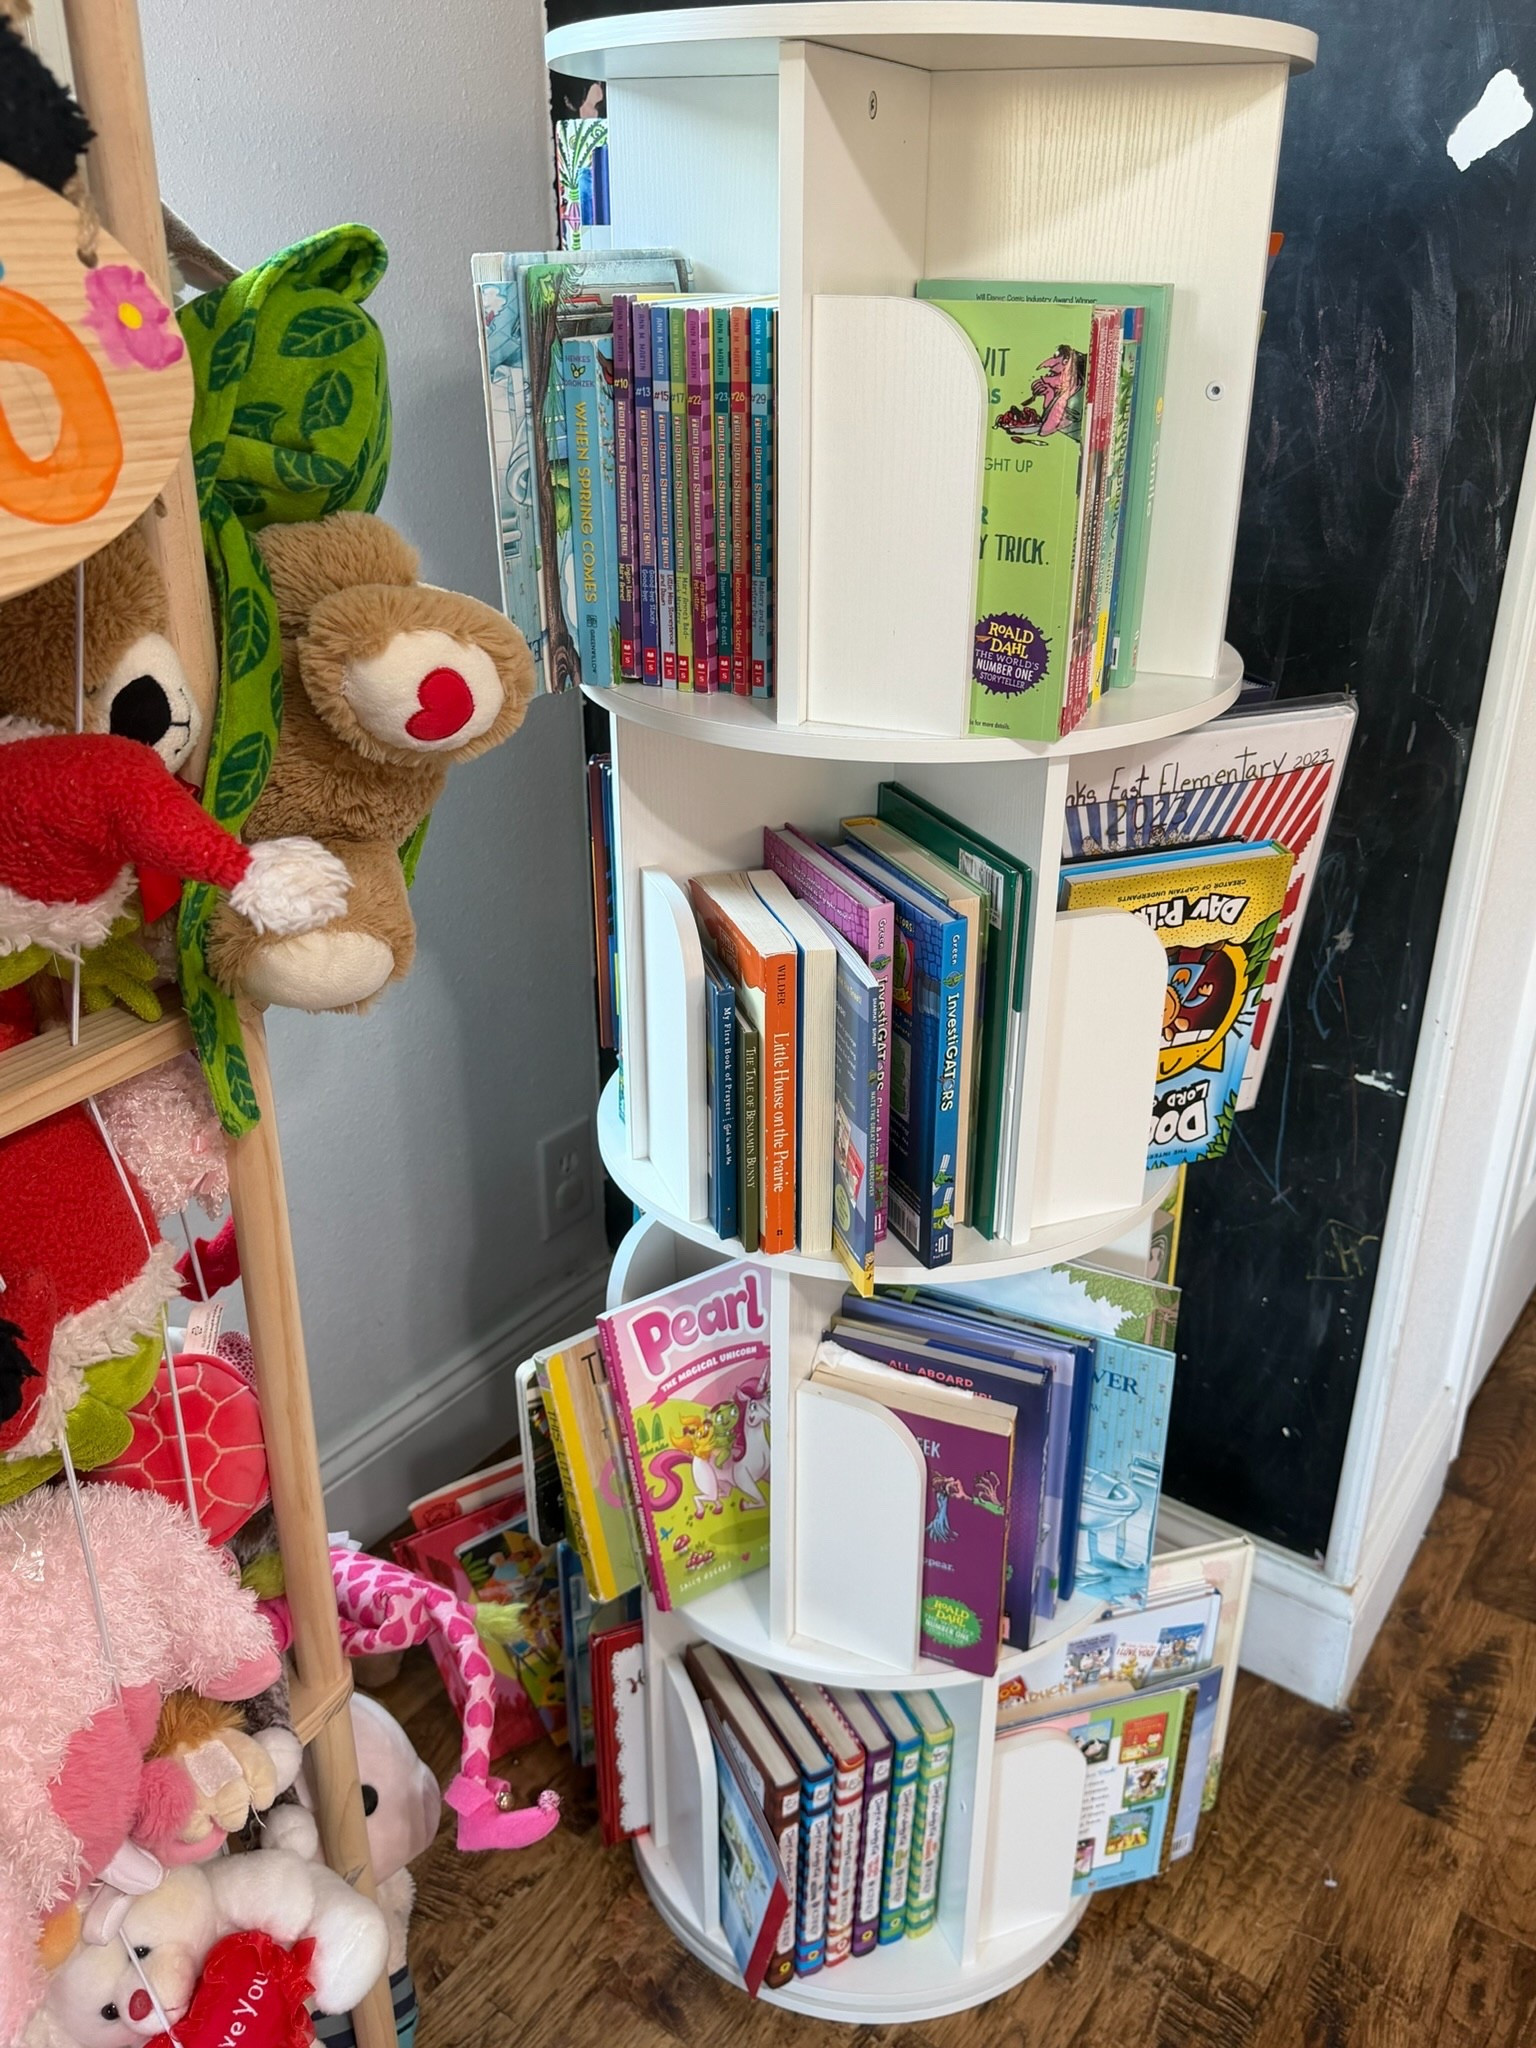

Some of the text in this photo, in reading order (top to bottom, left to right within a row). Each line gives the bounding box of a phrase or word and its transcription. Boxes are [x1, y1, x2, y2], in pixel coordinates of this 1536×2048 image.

[1015, 459, 1033, 472] UP
[575, 402, 598, 604] WHEN SPRING COMES
[994, 534, 1049, 565] TRICK.
[721, 598, 726, 609] on
[988, 622, 1034, 645] ROALD
[976, 649, 1040, 671] THE WORLD'S
[990, 638, 1029, 660] DAHL
[976, 658, 1034, 682] NUMBER ONE
[979, 671, 1026, 689] STORYTELLER
[1108, 766, 1149, 801] East
[1159, 746, 1288, 796] Elementary
[1293, 748, 1330, 768] 2023
[1118, 890, 1166, 903] UNDERPANTS
[1172, 885, 1200, 896] CAPTAIN
[1215, 878, 1247, 890] CREATOR
[1190, 894, 1247, 924] DAV
[951, 934, 961, 966] Green
[777, 964, 786, 1006] WILDER
[723, 1007, 731, 1020] My
[725, 1073, 732, 1081] of
[724, 1084, 732, 1115] Prayers
[1166, 1082, 1209, 1107] LORD
[746, 1046, 756, 1188] THE TALE OF BENJAMIN BUNNY
[774, 1032, 789, 1192] Little House on the Prairie
[632, 1275, 764, 1376] Pearl
[660, 1346, 757, 1392] THE MAGICAL UNICORN
[888, 1359, 974, 1387] ALL ABOARD
[622, 1437, 631, 1456] THE
[627, 1458, 642, 1504] MAGICAL
[548, 1410, 590, 1563] THIS LITTLE PIGGY
[934, 1600, 970, 1619] ROALD
[936, 1610, 966, 1628] DAHL
